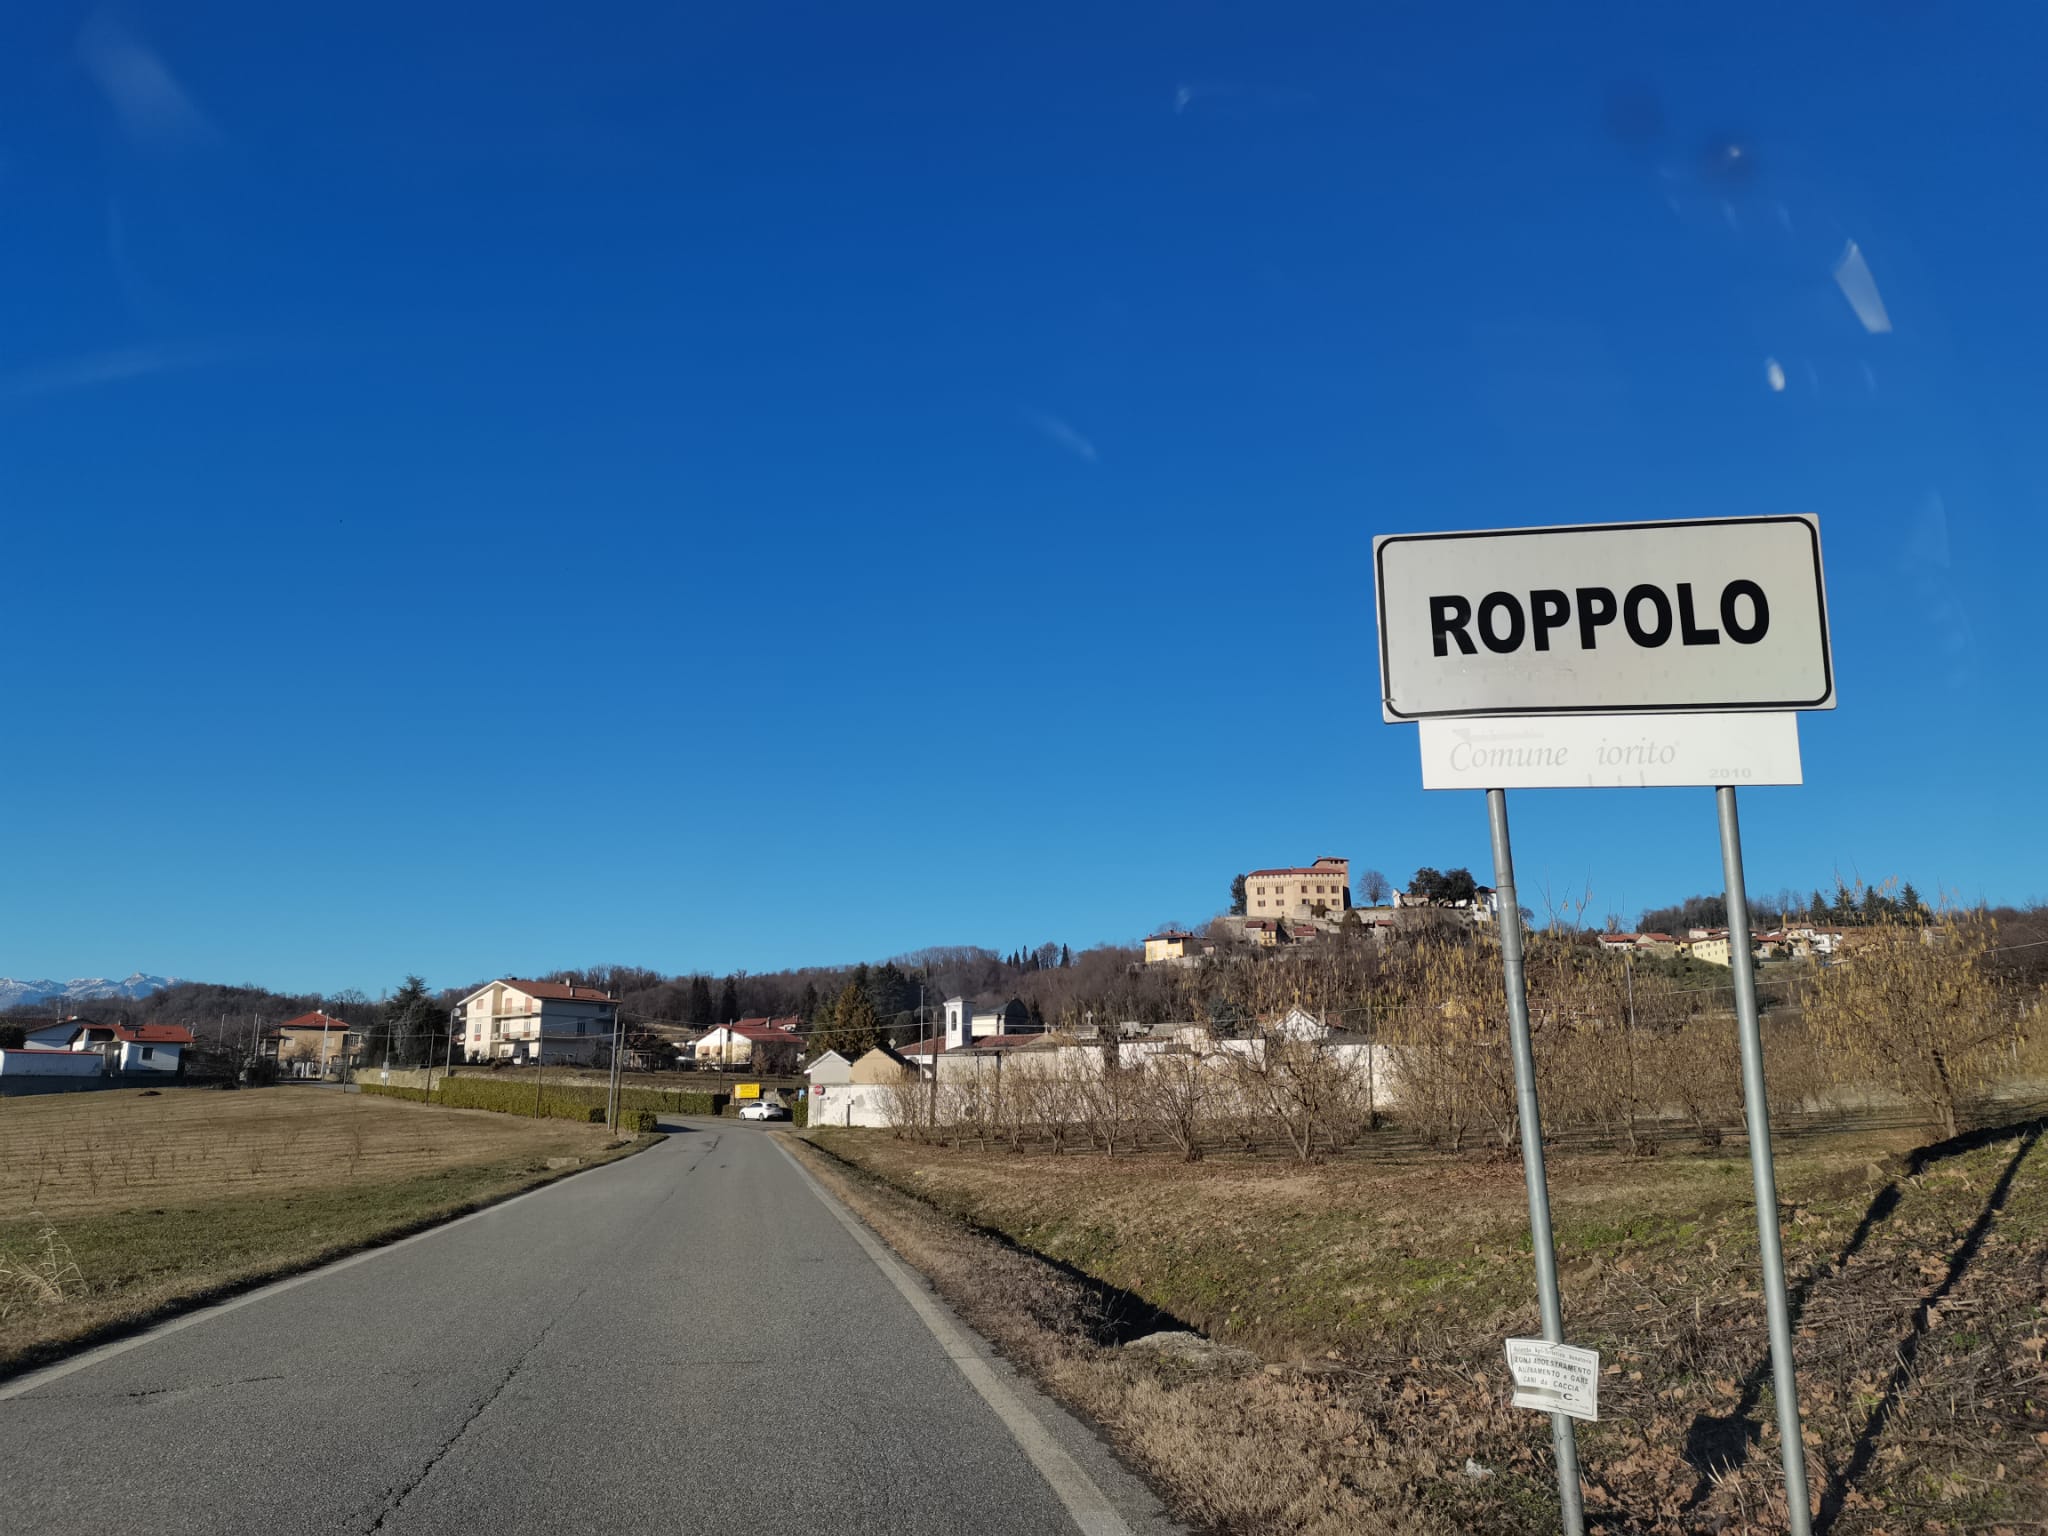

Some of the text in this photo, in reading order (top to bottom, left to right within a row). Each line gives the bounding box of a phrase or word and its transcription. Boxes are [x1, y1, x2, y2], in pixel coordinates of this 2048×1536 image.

[1429, 579, 1769, 657] ROPPOLO
[1449, 741, 1568, 772] Comune
[1708, 767, 1752, 779] 2010
[1523, 1375, 1537, 1384] CANI
[1553, 1380, 1580, 1393] CACCIA
